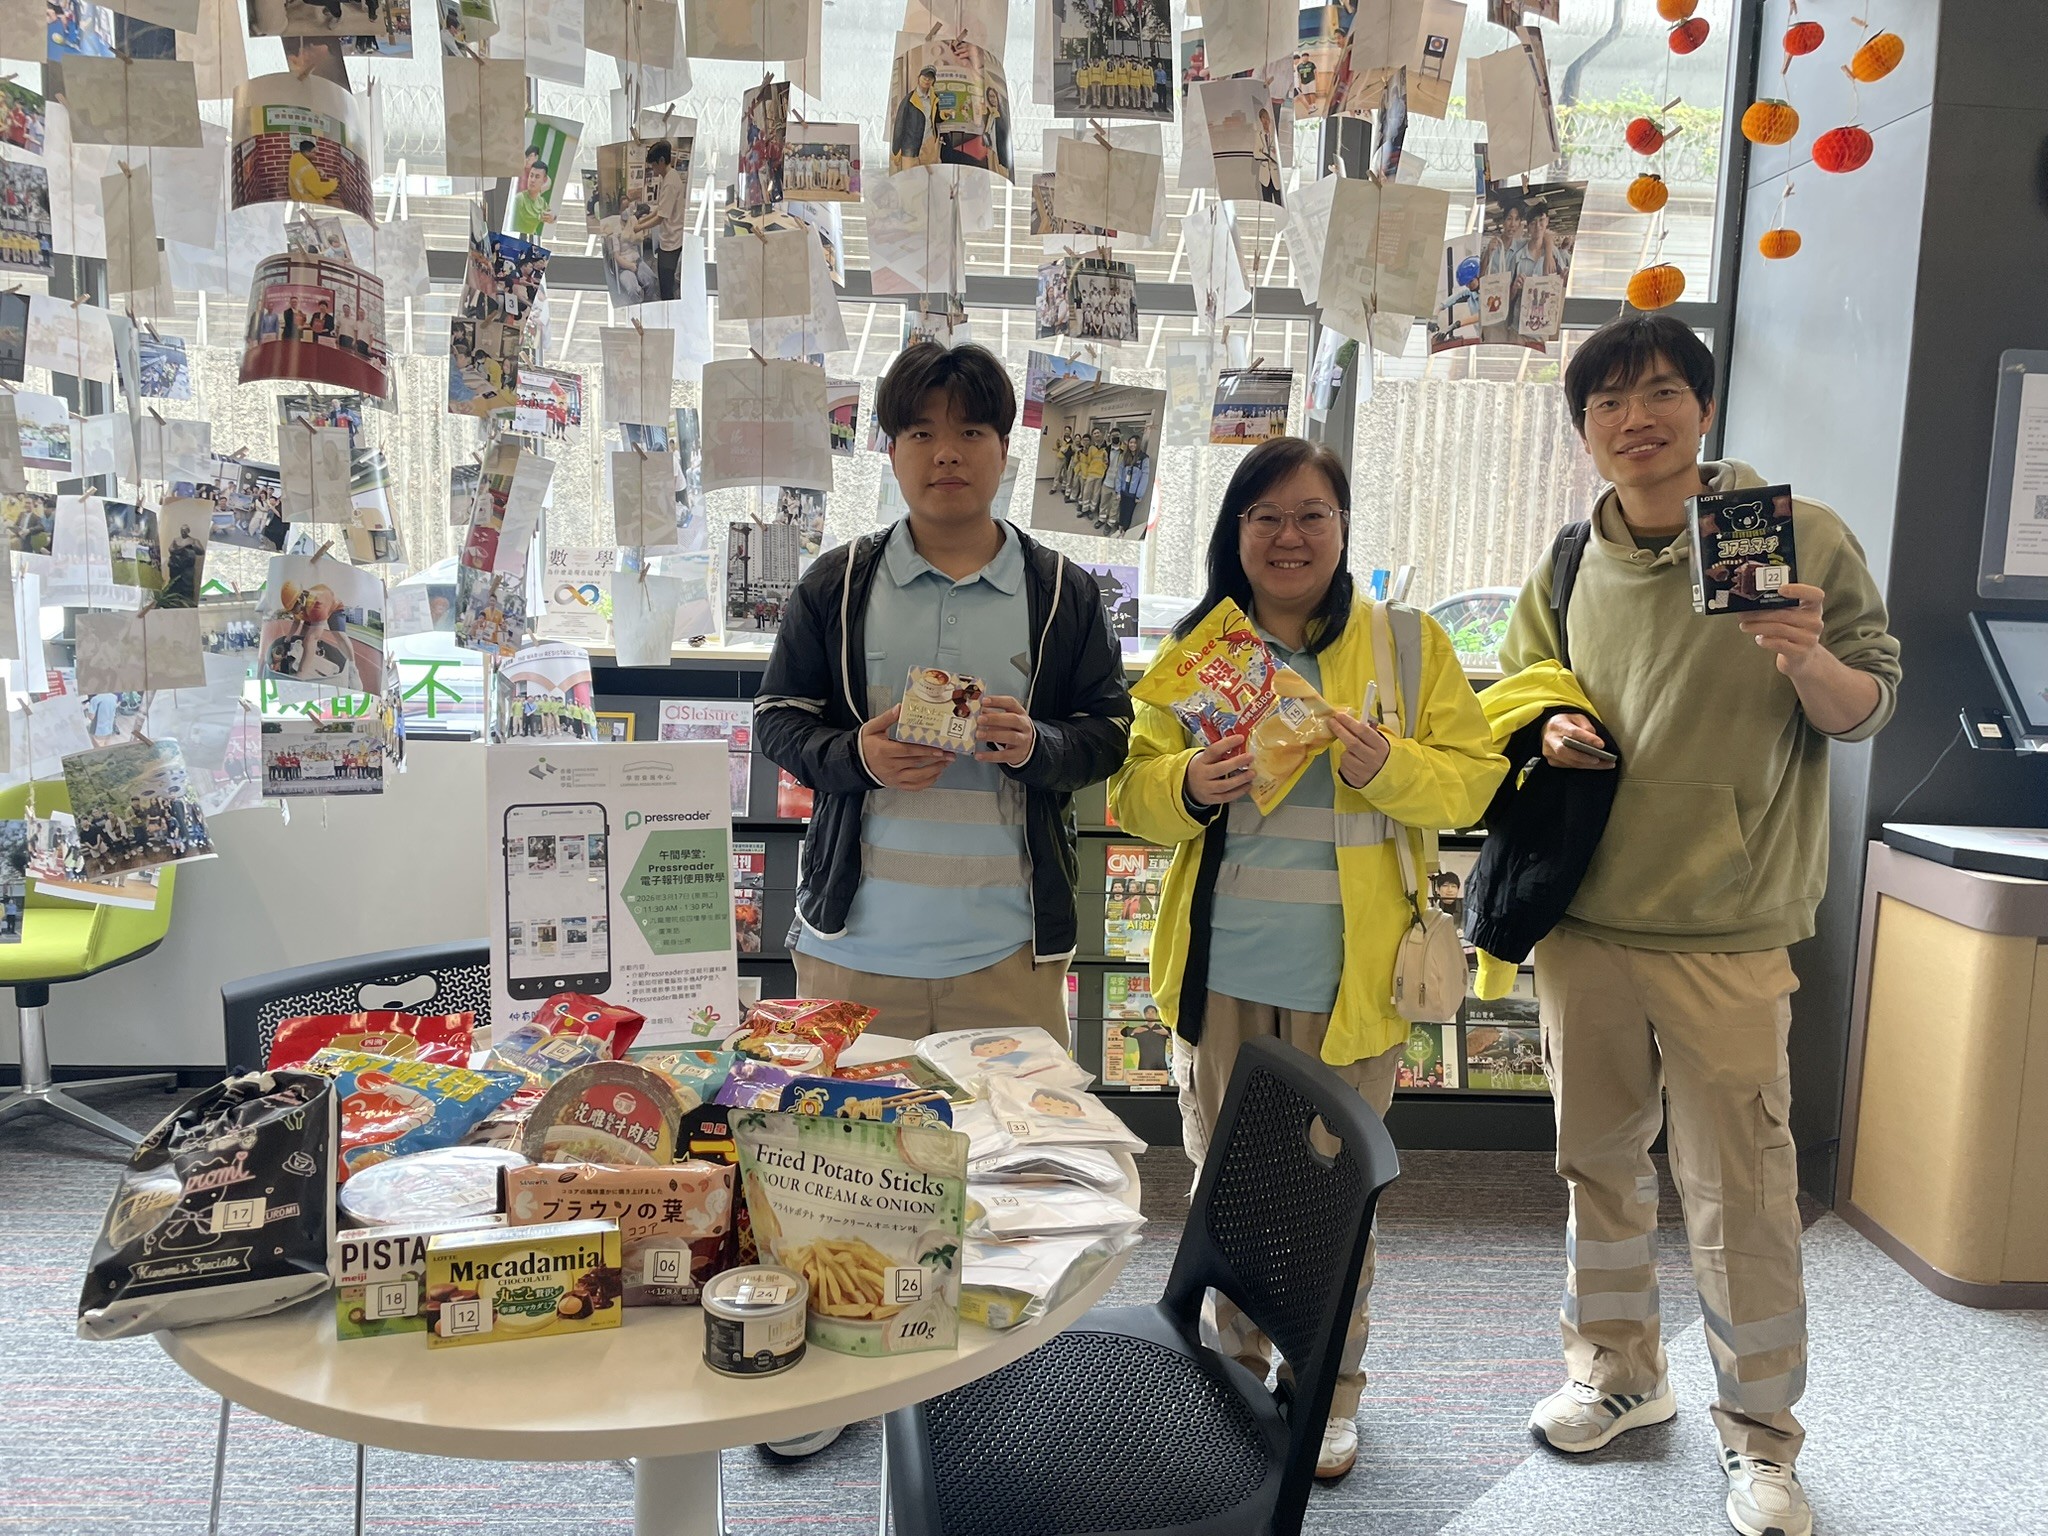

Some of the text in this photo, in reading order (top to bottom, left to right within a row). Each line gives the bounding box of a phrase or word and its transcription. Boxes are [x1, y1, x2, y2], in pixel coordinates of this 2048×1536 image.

[509, 299, 515, 309] 3
[550, 549, 614, 568] 數 學
[1768, 573, 1779, 582] 22
[1176, 638, 1218, 678] Calbee
[398, 659, 463, 719] 不
[1290, 708, 1301, 718] 15
[951, 722, 963, 732] 25
[644, 811, 711, 824] pressreader
[648, 862, 715, 873] Pressreader
[1107, 854, 1145, 872] CNN
[640, 872, 726, 886] 電子報刊使用教學
[1109, 976, 1126, 986] 早安
[700, 1122, 727, 1136] 明星
[1012, 1123, 1026, 1132] 33
[755, 1143, 944, 1197] Fried Potato Sticks
[763, 1171, 936, 1215] SOUR CREAM & ONION
[231, 1208, 249, 1220] 17
[543, 1198, 685, 1223] ブラウンの葉
[628, 1222, 658, 1236] ココア
[191, 1255, 240, 1274] Specials
[433, 1254, 458, 1262] LOTTE
[449, 1246, 600, 1283] Macadamia
[659, 1259, 676, 1272] 06
[341, 1273, 368, 1283] meiji
[497, 1274, 552, 1286] CHOCOLATE
[901, 1277, 919, 1292] 26
[385, 1293, 403, 1305] 18
[458, 1310, 476, 1323] 12
[899, 1320, 937, 1340] 110g
